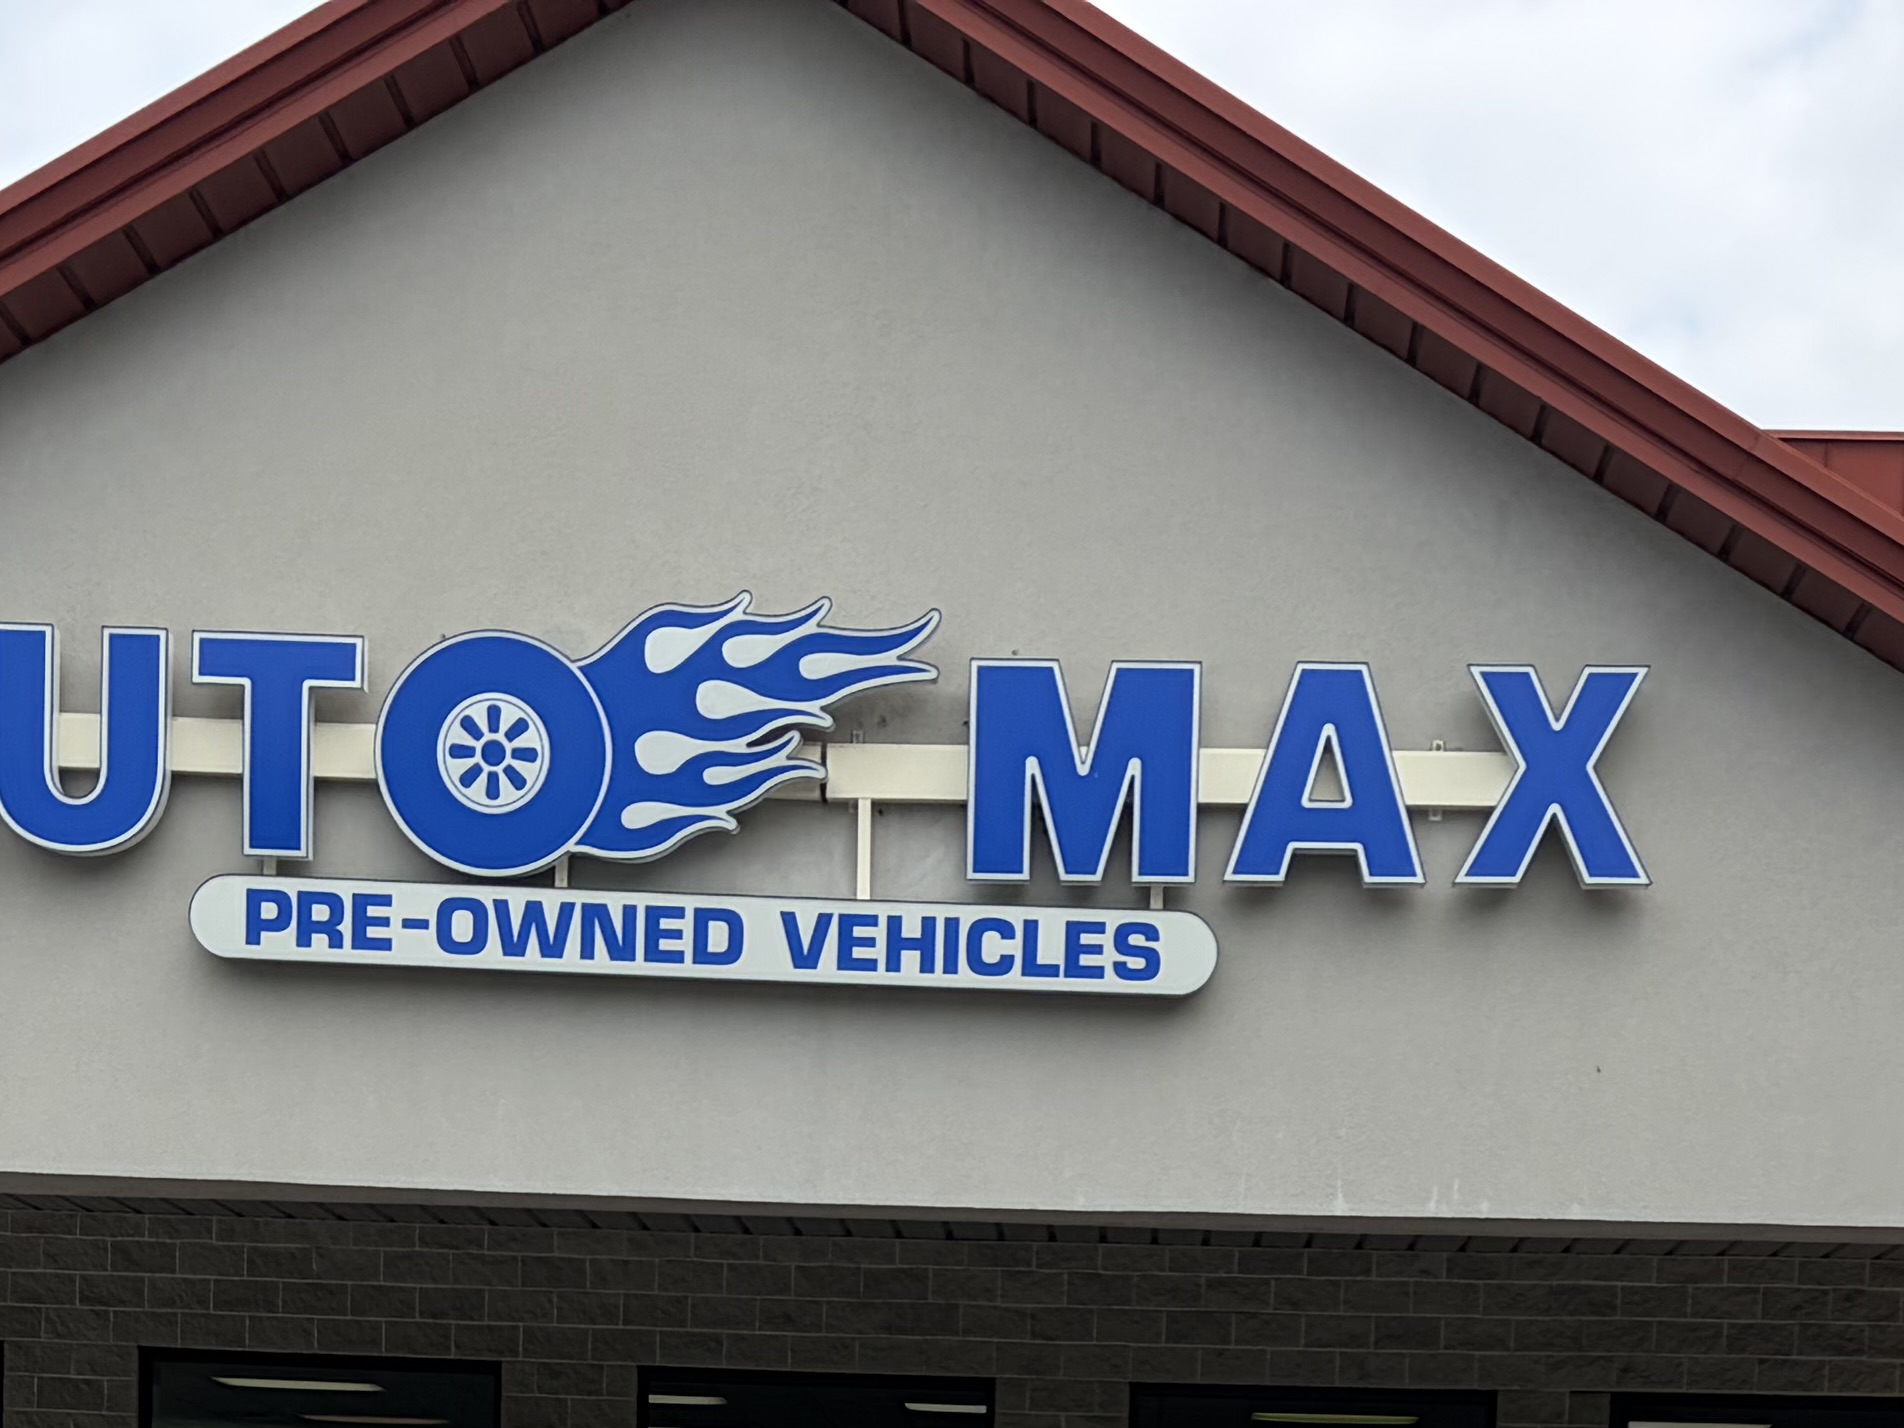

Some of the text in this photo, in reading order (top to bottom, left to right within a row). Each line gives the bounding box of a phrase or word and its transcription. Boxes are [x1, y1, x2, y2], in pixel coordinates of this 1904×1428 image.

[965, 657, 1653, 889] MAX
[243, 888, 1162, 983] PRE-OWNED VEHICLES
